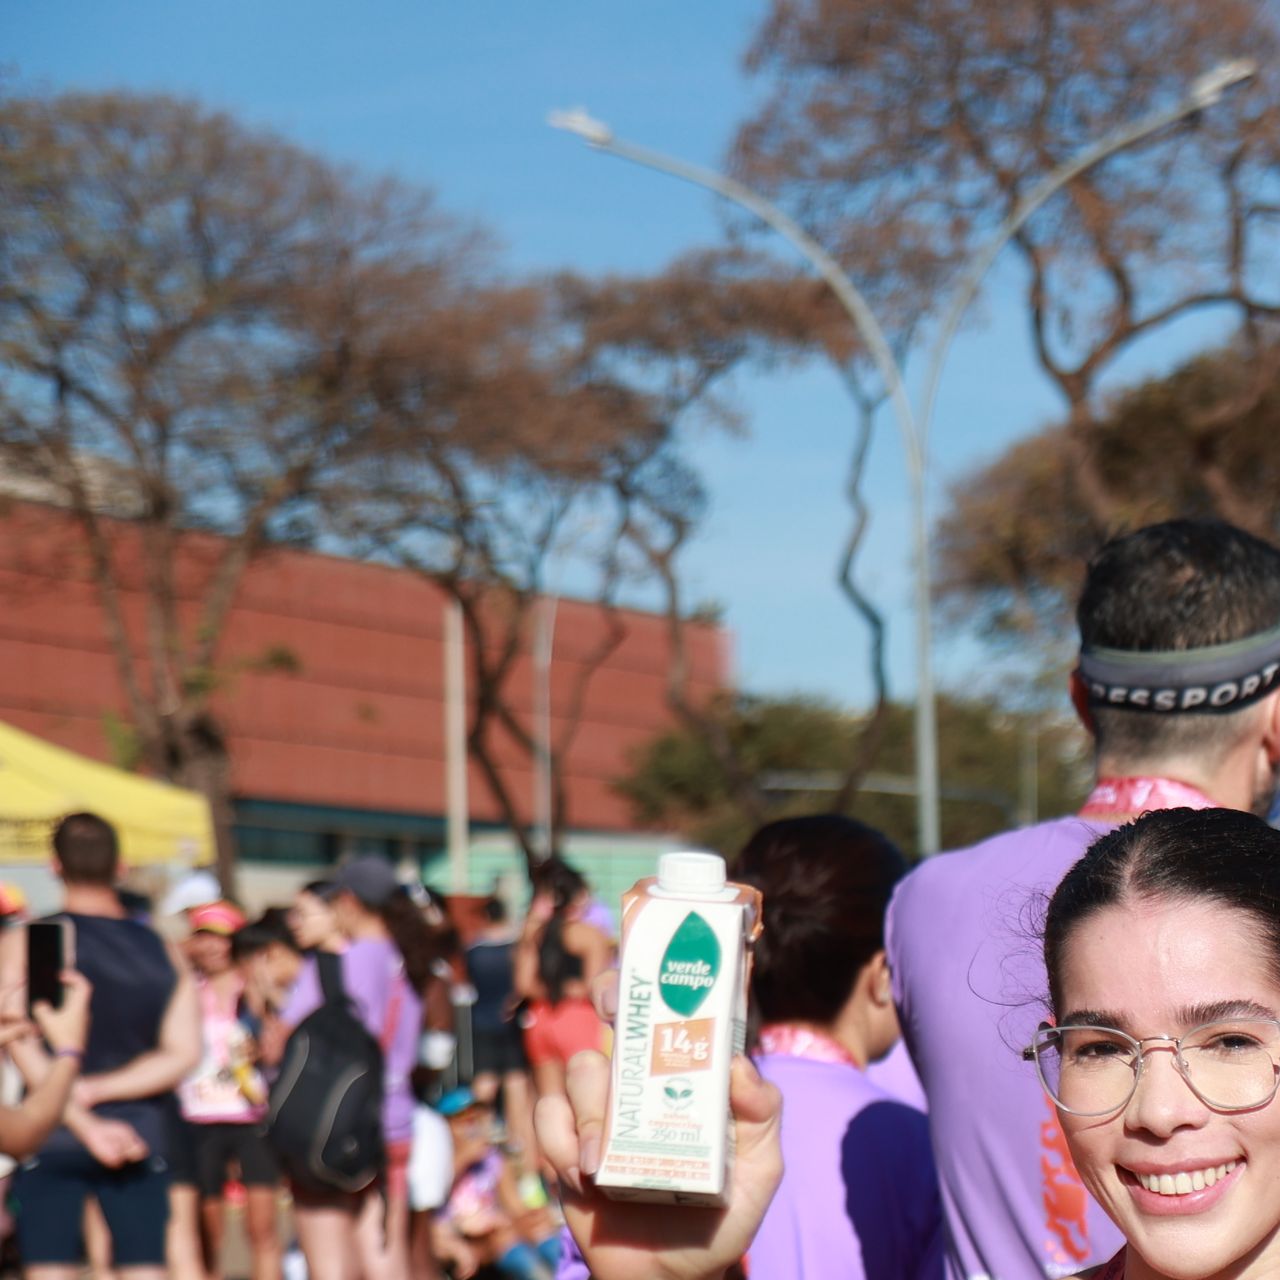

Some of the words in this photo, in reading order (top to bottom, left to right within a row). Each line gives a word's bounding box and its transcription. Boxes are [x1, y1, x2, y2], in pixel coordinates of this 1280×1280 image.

[666, 959, 711, 976] verde
[660, 973, 714, 991] campo
[681, 1127, 701, 1142] ml
